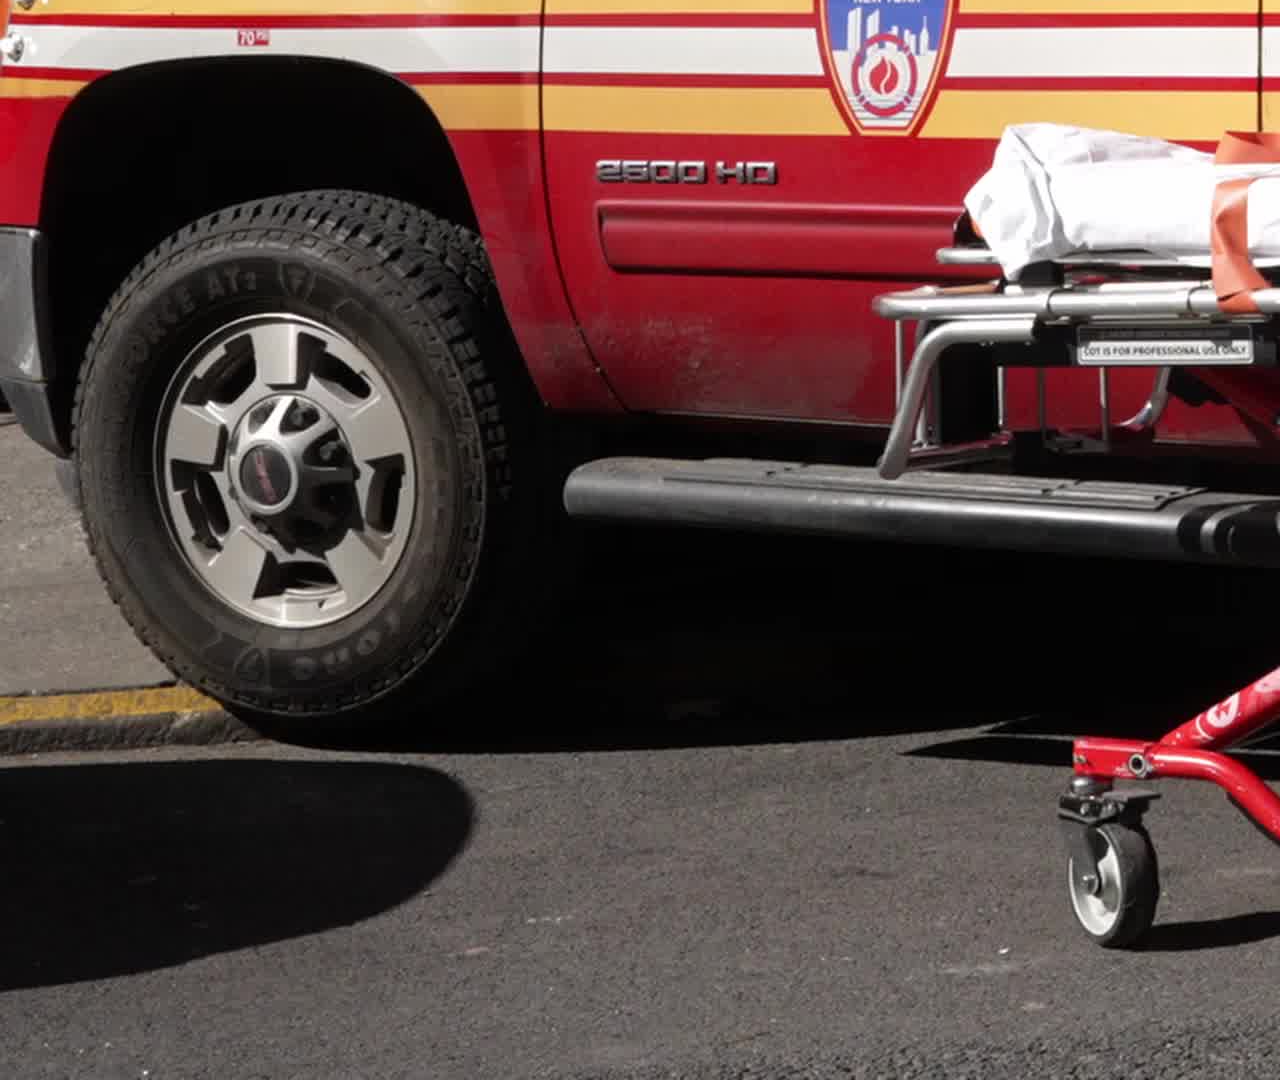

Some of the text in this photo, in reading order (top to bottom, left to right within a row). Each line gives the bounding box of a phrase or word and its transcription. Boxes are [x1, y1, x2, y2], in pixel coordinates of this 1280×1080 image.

[239, 30, 256, 47] 70
[595, 159, 777, 185] 2500 HD
[1112, 345, 1131, 356] FOR
[1133, 344, 1201, 356] PROFESSIONAL
[1202, 344, 1219, 355] USE
[1221, 343, 1247, 355] ONLY
